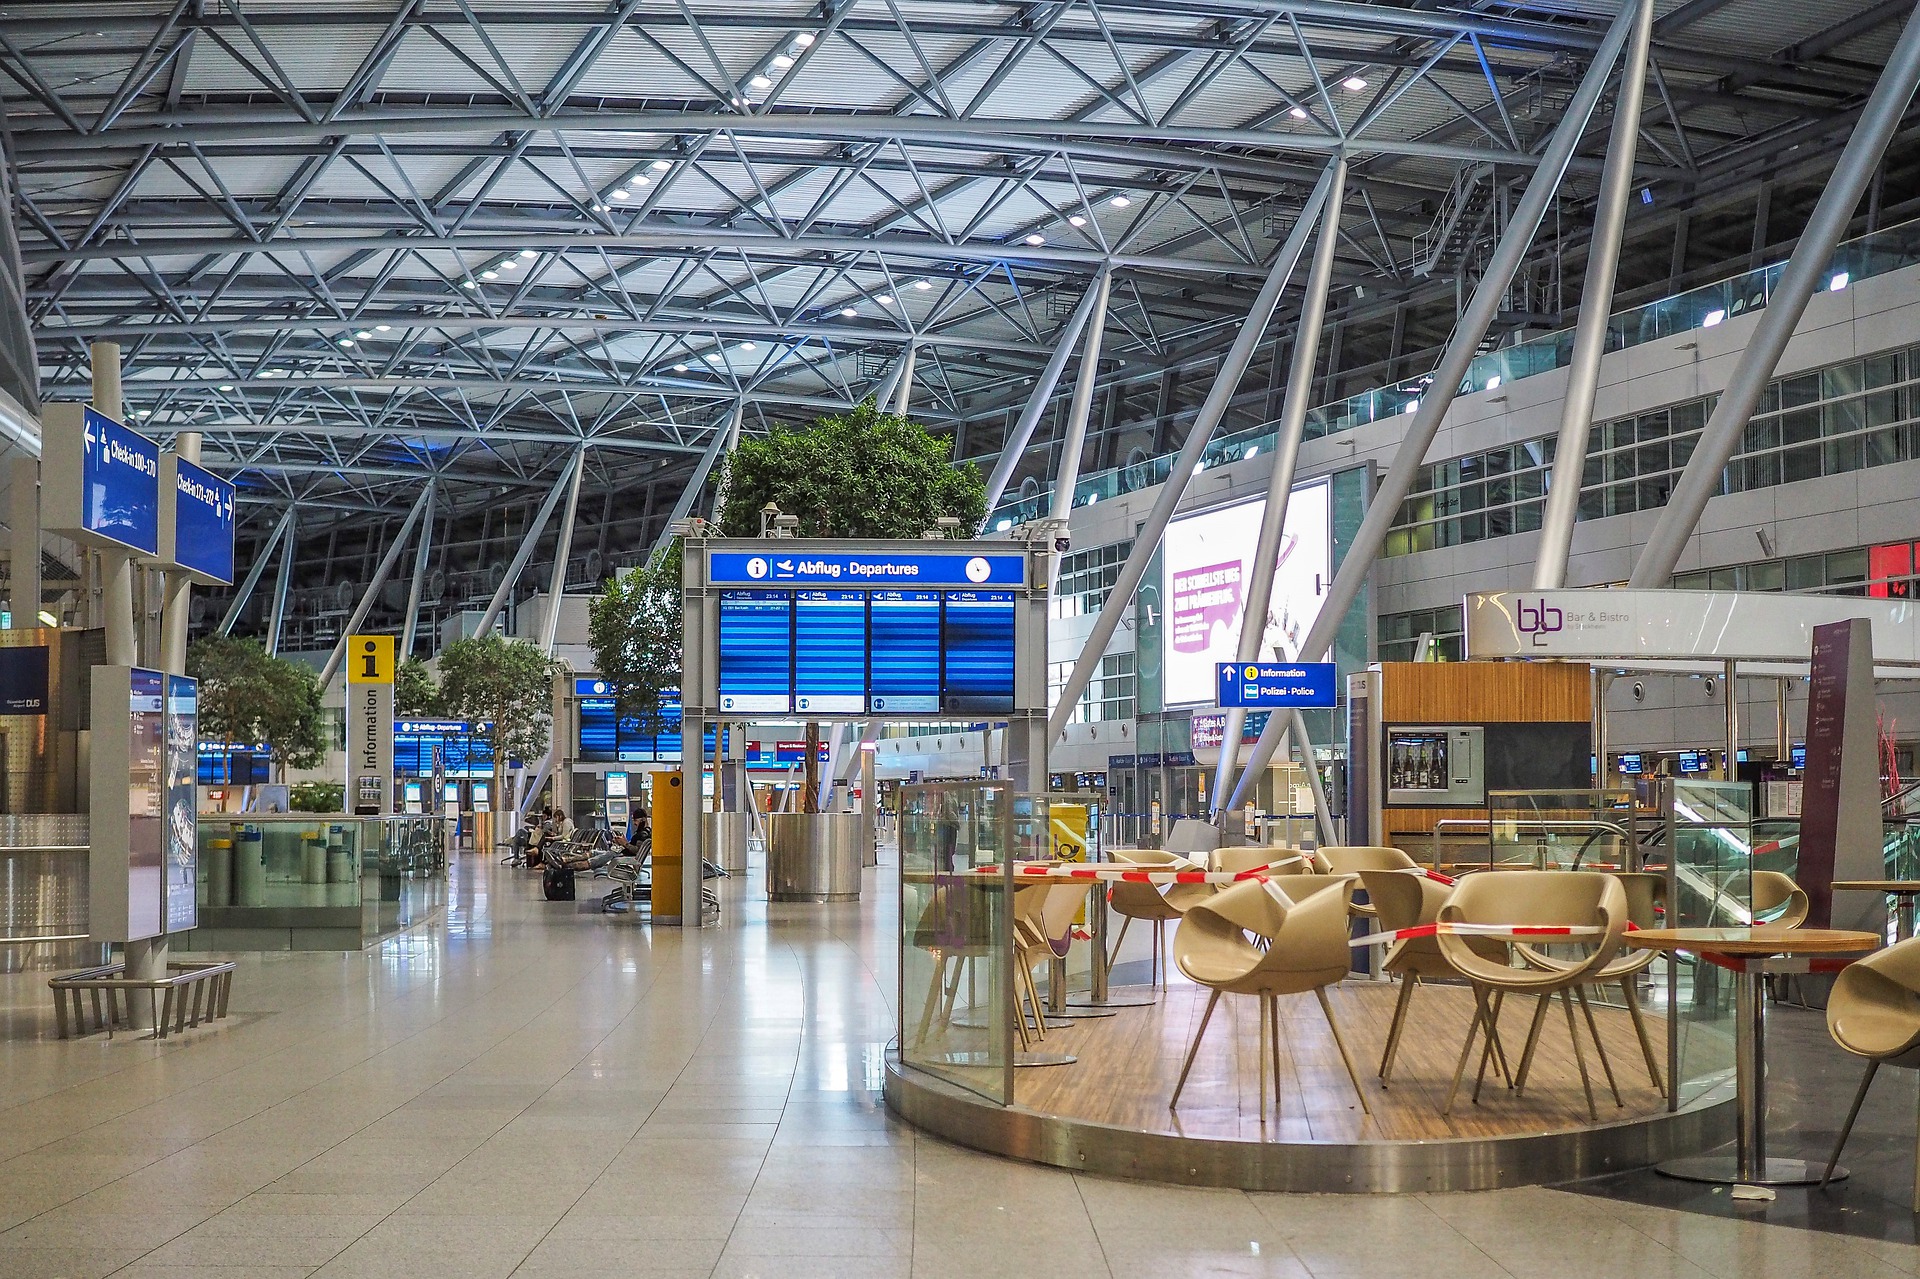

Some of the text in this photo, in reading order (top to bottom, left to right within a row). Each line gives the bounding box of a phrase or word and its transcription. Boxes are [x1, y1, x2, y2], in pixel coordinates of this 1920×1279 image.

[111, 440, 135, 467] Check-in
[177, 473, 196, 495] Check-in
[797, 561, 841, 577] Abflug
[849, 561, 919, 577] Departures
[1566, 611, 1630, 622] Bar & Bistro
[1260, 668, 1306, 678] Information
[1260, 686, 1287, 696] Polizei
[1291, 686, 1315, 696] Police
[26, 699, 40, 707] DUS
[364, 689, 377, 769] Information
